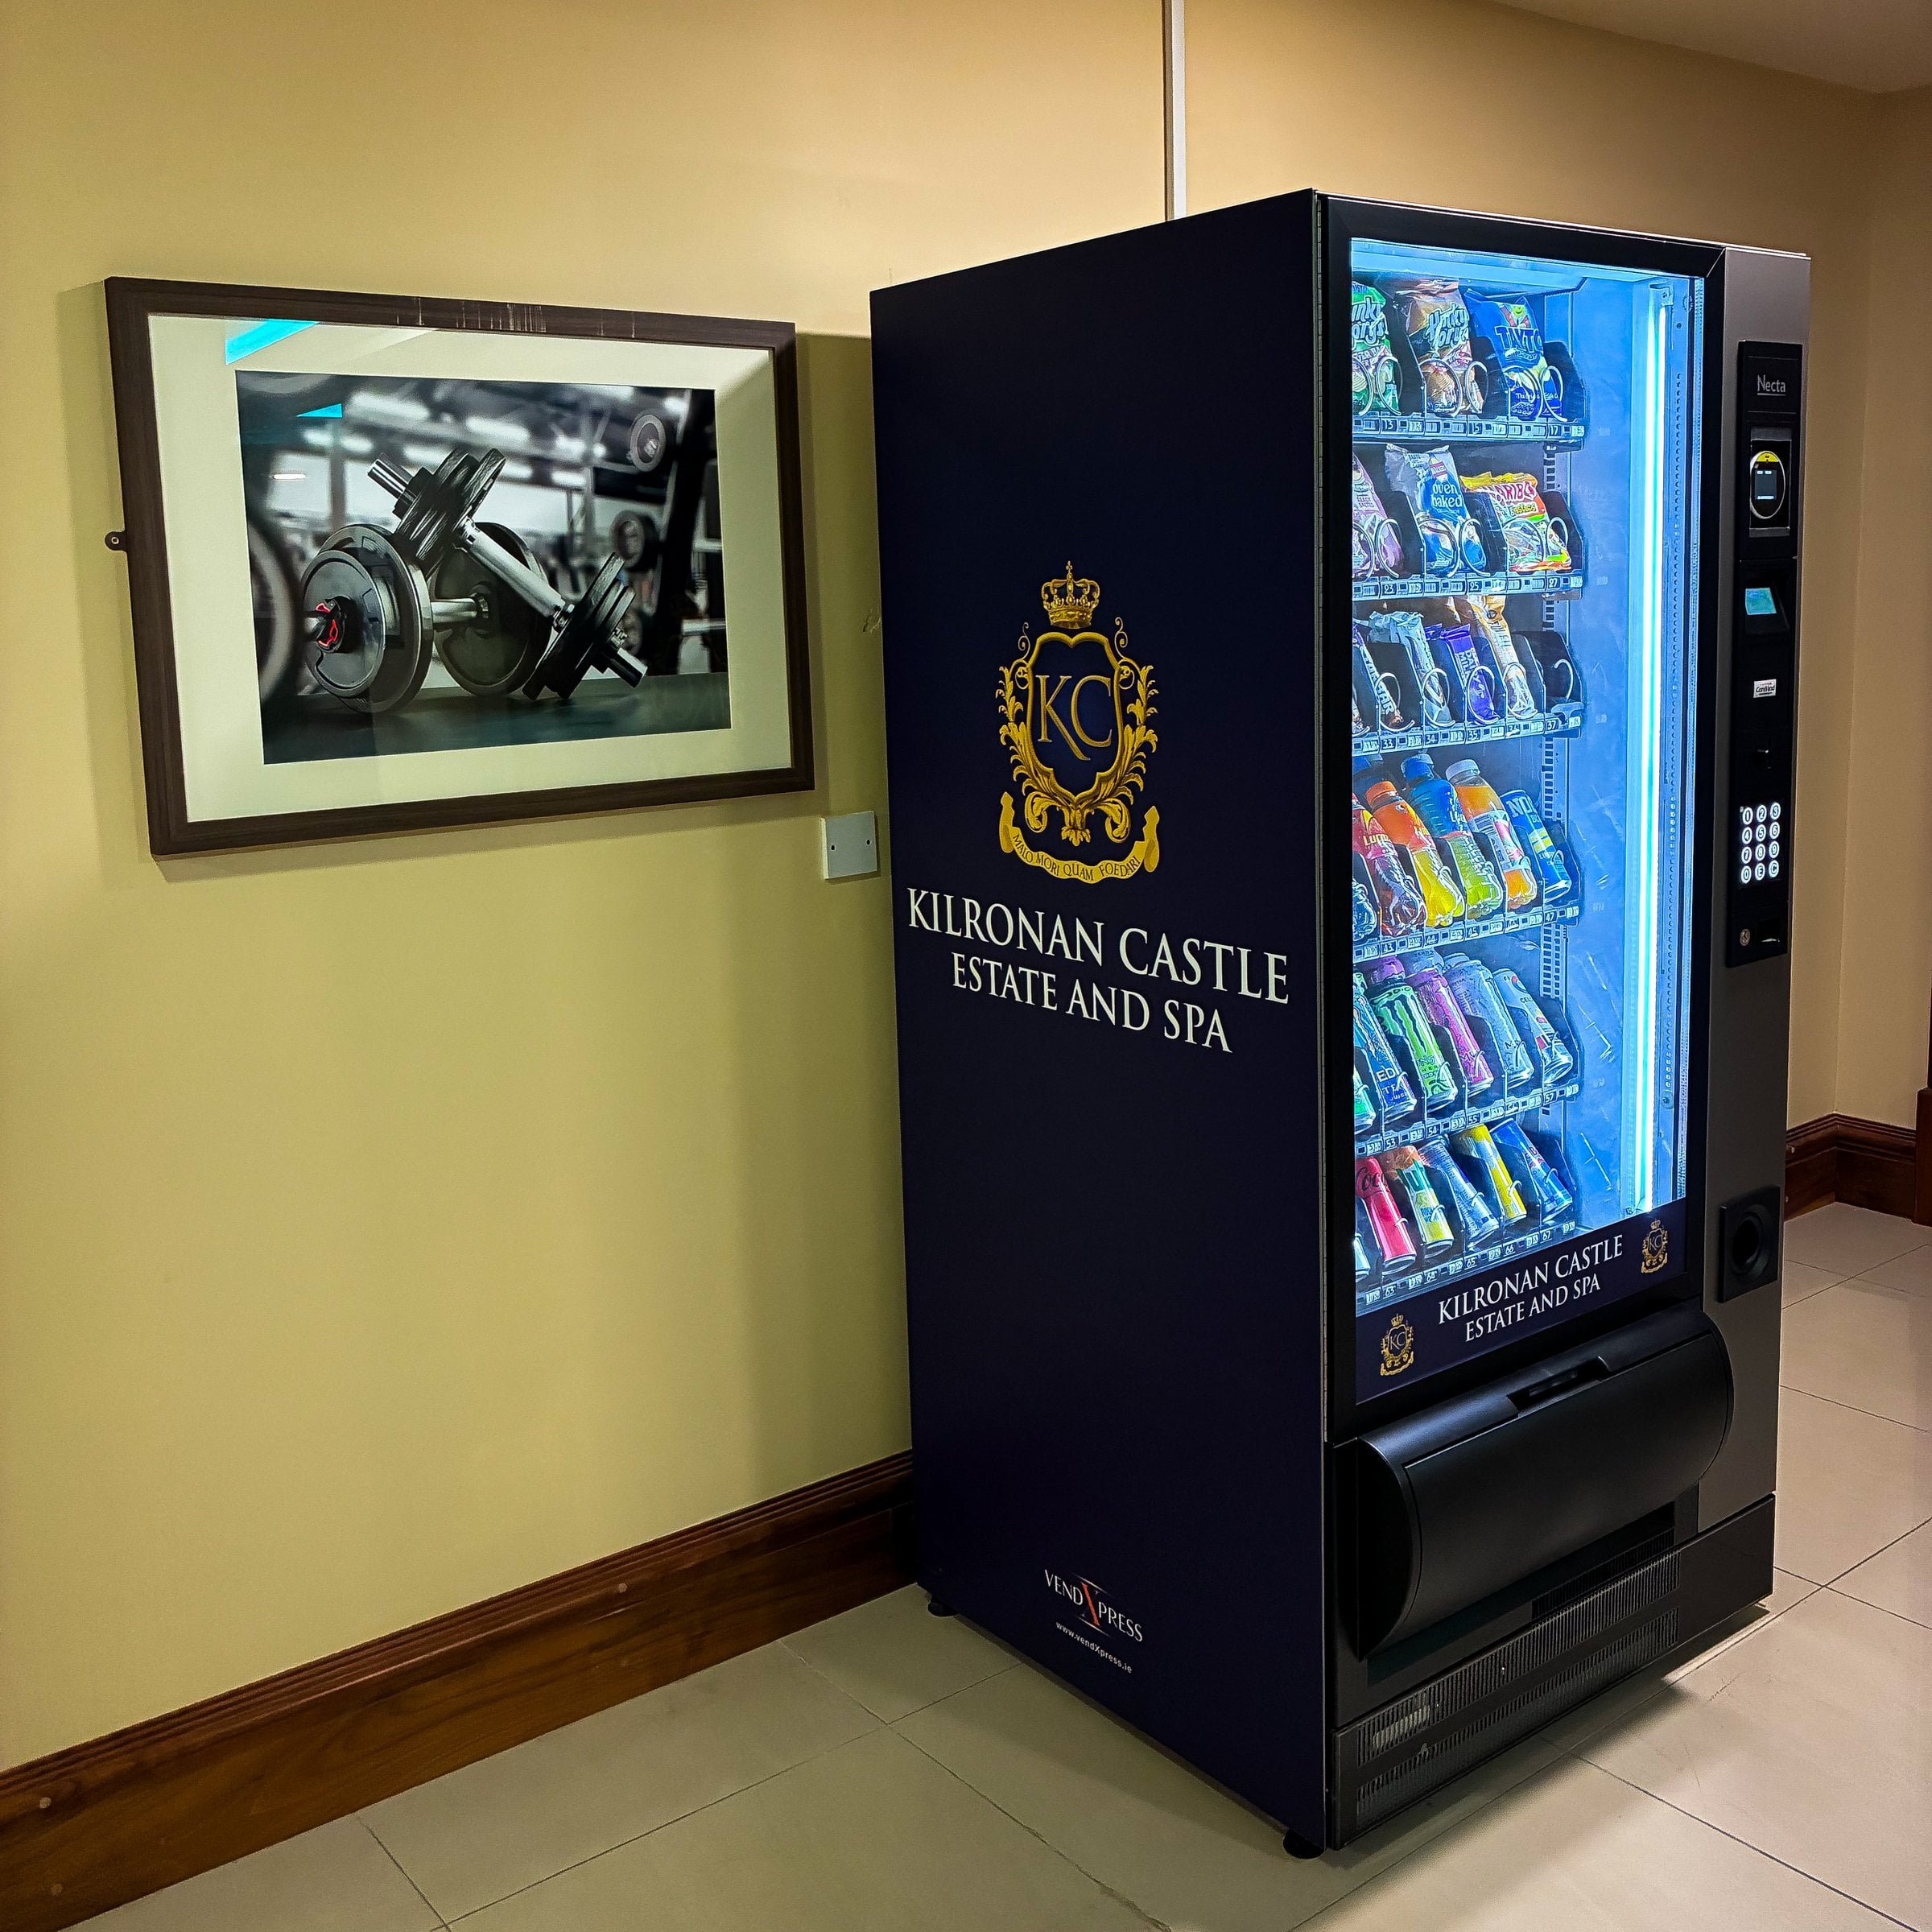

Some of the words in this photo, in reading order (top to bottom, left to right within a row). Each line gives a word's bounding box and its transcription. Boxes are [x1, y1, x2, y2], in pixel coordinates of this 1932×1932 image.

[1757, 374, 1786, 392] Necta
[1384, 419, 1393, 430] 13
[1550, 426, 1558, 435] 17
[1432, 483, 1458, 494] oven
[1431, 494, 1463, 508] baked
[1549, 578, 1558, 588] 27
[1384, 584, 1394, 594] 23
[1034, 675, 1113, 761] KC
[1547, 720, 1557, 730] 37
[1426, 734, 1436, 744] 34
[1468, 730, 1478, 740] 35
[1383, 739, 1393, 749] 33
[1013, 834, 1034, 863] MALO
[1035, 853, 1059, 876] MORI
[1063, 864, 1094, 881] QUAM
[1099, 856, 1141, 877] FOEDARI
[1545, 911, 1554, 921] 47
[906, 887, 1104, 966] KILRONAN
[1119, 927, 1289, 1005] CASTLE
[1383, 943, 1393, 953] 43
[951, 952, 1058, 1011] ESTATE
[1066, 978, 1150, 1032] AND
[1164, 1000, 1232, 1053] SPA
[1544, 1093, 1554, 1103] 57
[1468, 1114, 1478, 1125] 55
[1427, 1125, 1438, 1136] 54
[1385, 1137, 1396, 1148] 53
[1542, 1231, 1551, 1241] 67
[1648, 1236, 1662, 1250] KC
[1505, 1245, 1514, 1254] 66
[1466, 1257, 1476, 1267] 65
[1439, 1262, 1549, 1324] KILRONAN
[1555, 1234, 1623, 1279] CASTLE
[1385, 1285, 1395, 1296] 63
[1465, 1298, 1525, 1342] ESTATE
[1529, 1286, 1567, 1317] AND
[1573, 1273, 1600, 1299] SPA
[1389, 1331, 1406, 1350] KC
